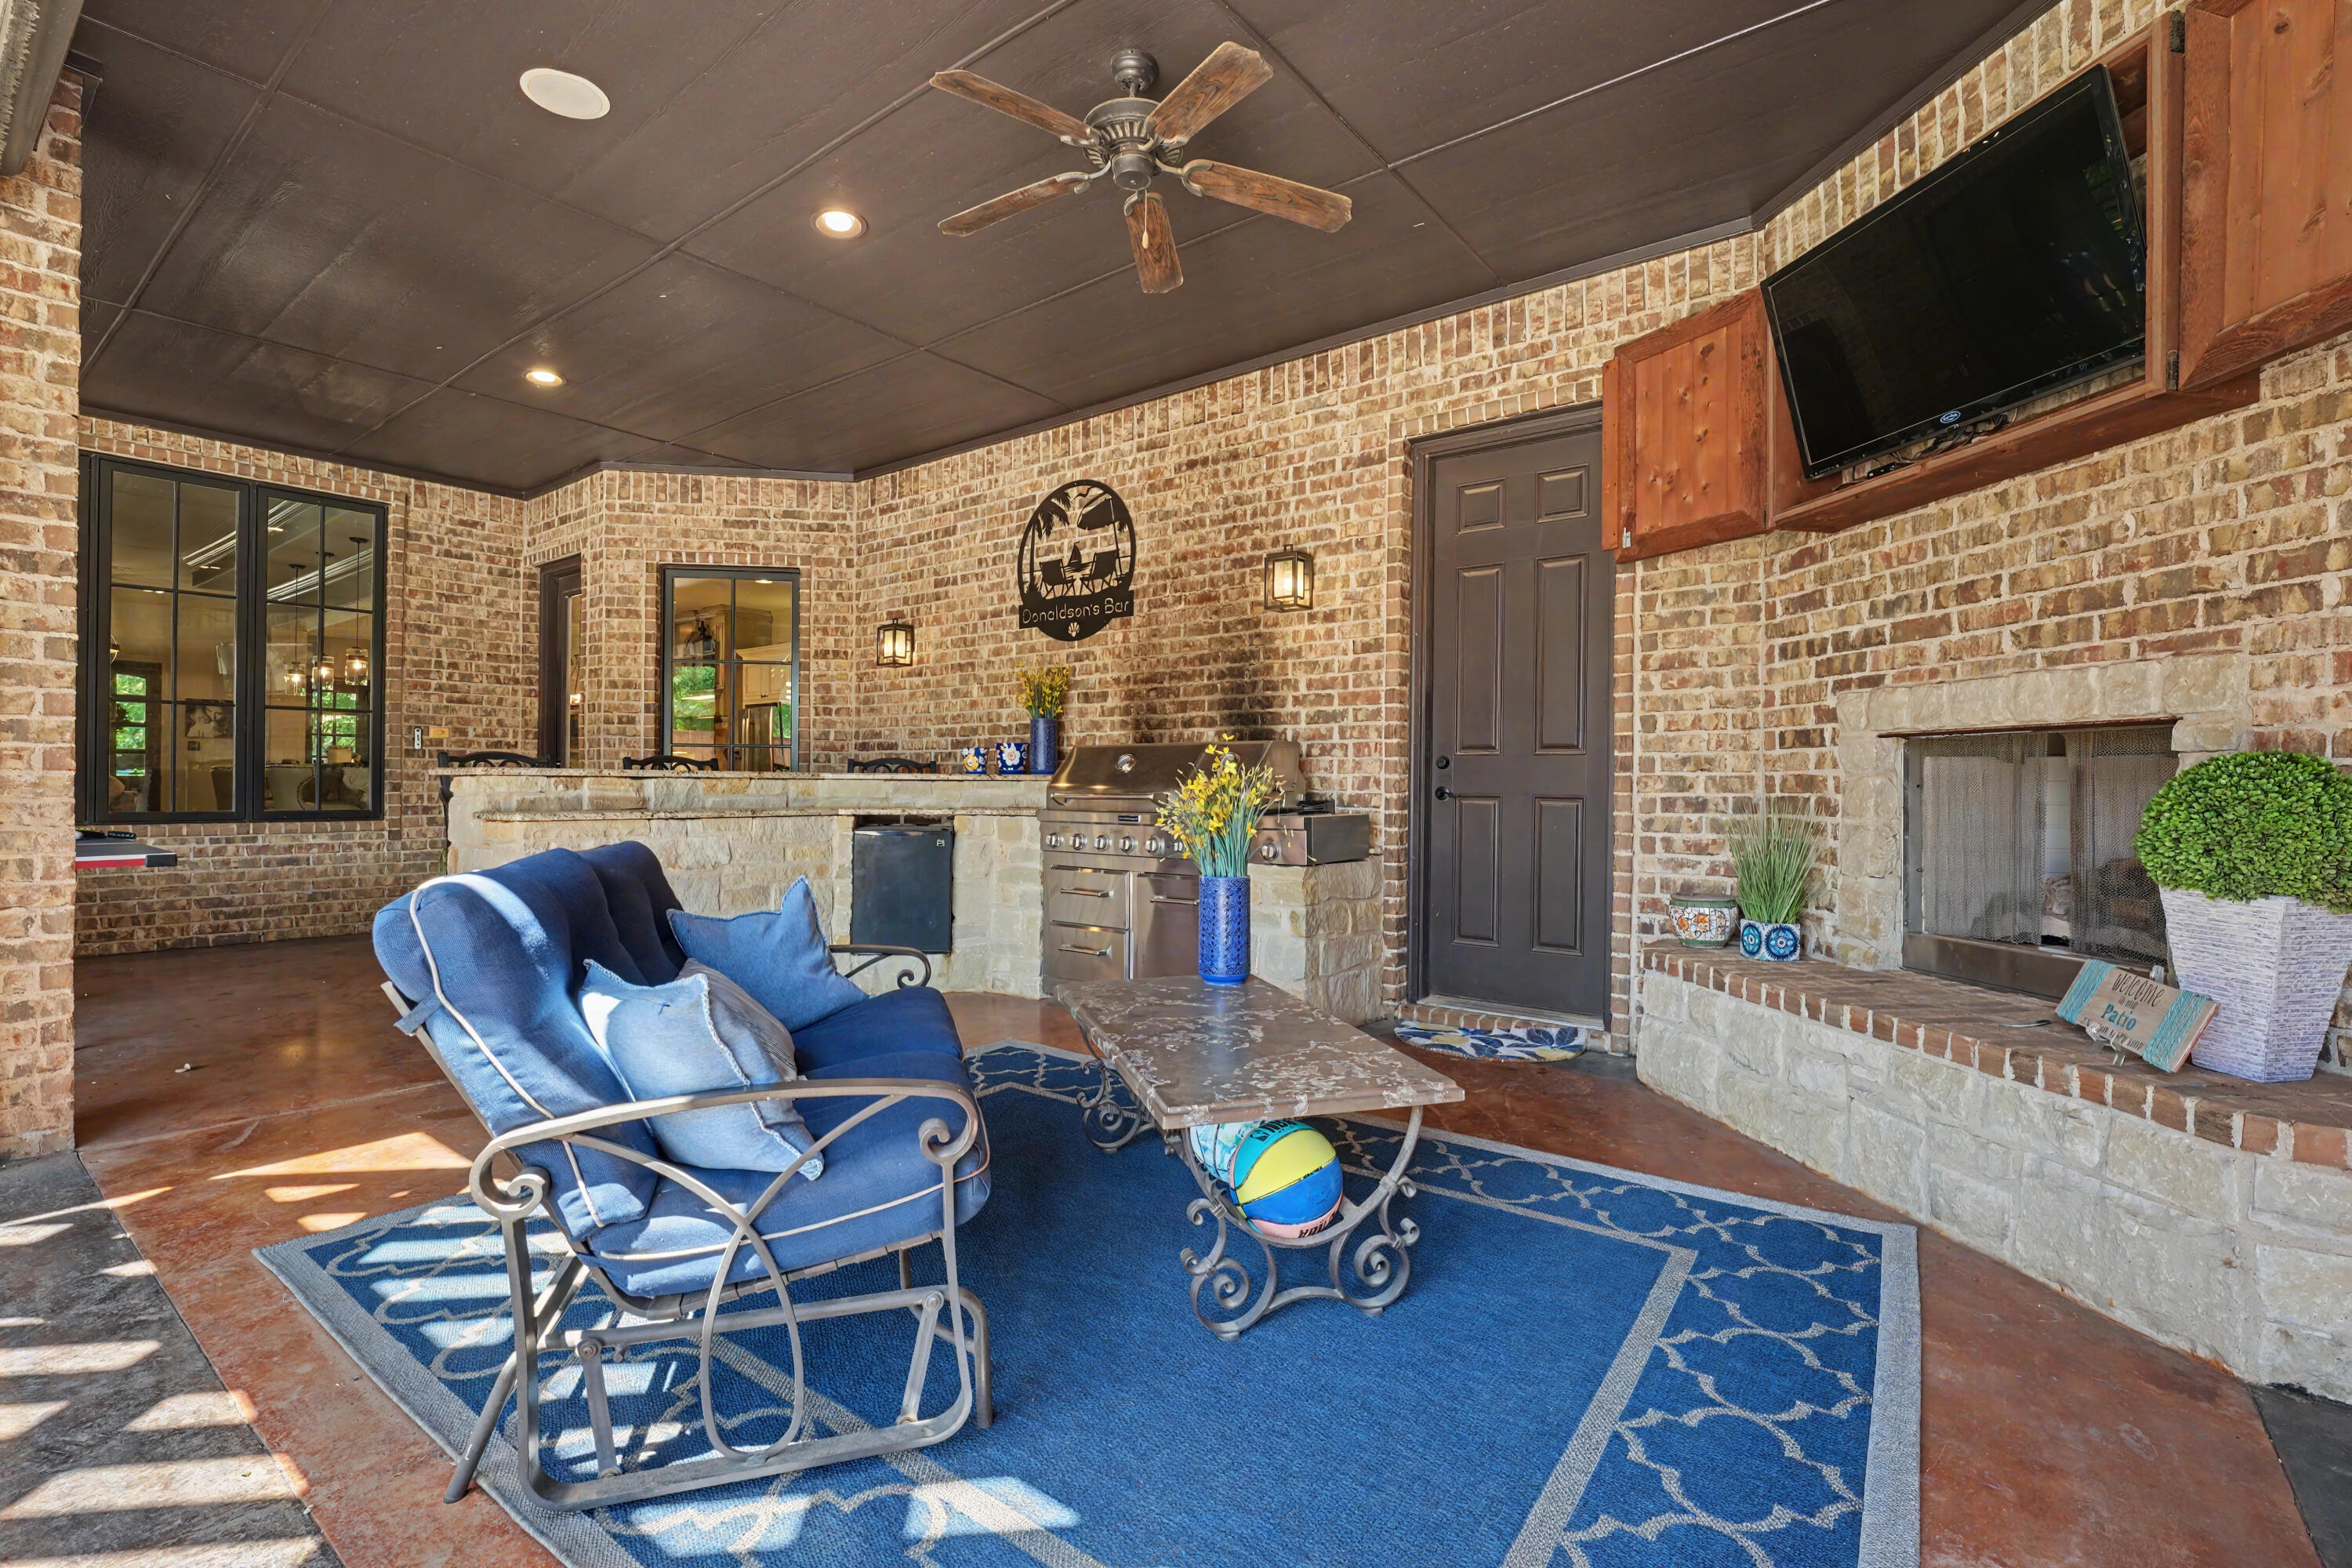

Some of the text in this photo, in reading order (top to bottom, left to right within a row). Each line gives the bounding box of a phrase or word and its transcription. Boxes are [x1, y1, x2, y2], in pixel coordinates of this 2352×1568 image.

[1022, 597, 1130, 624] Donaldson's Bar
[2100, 1003, 2136, 1031] Patio
